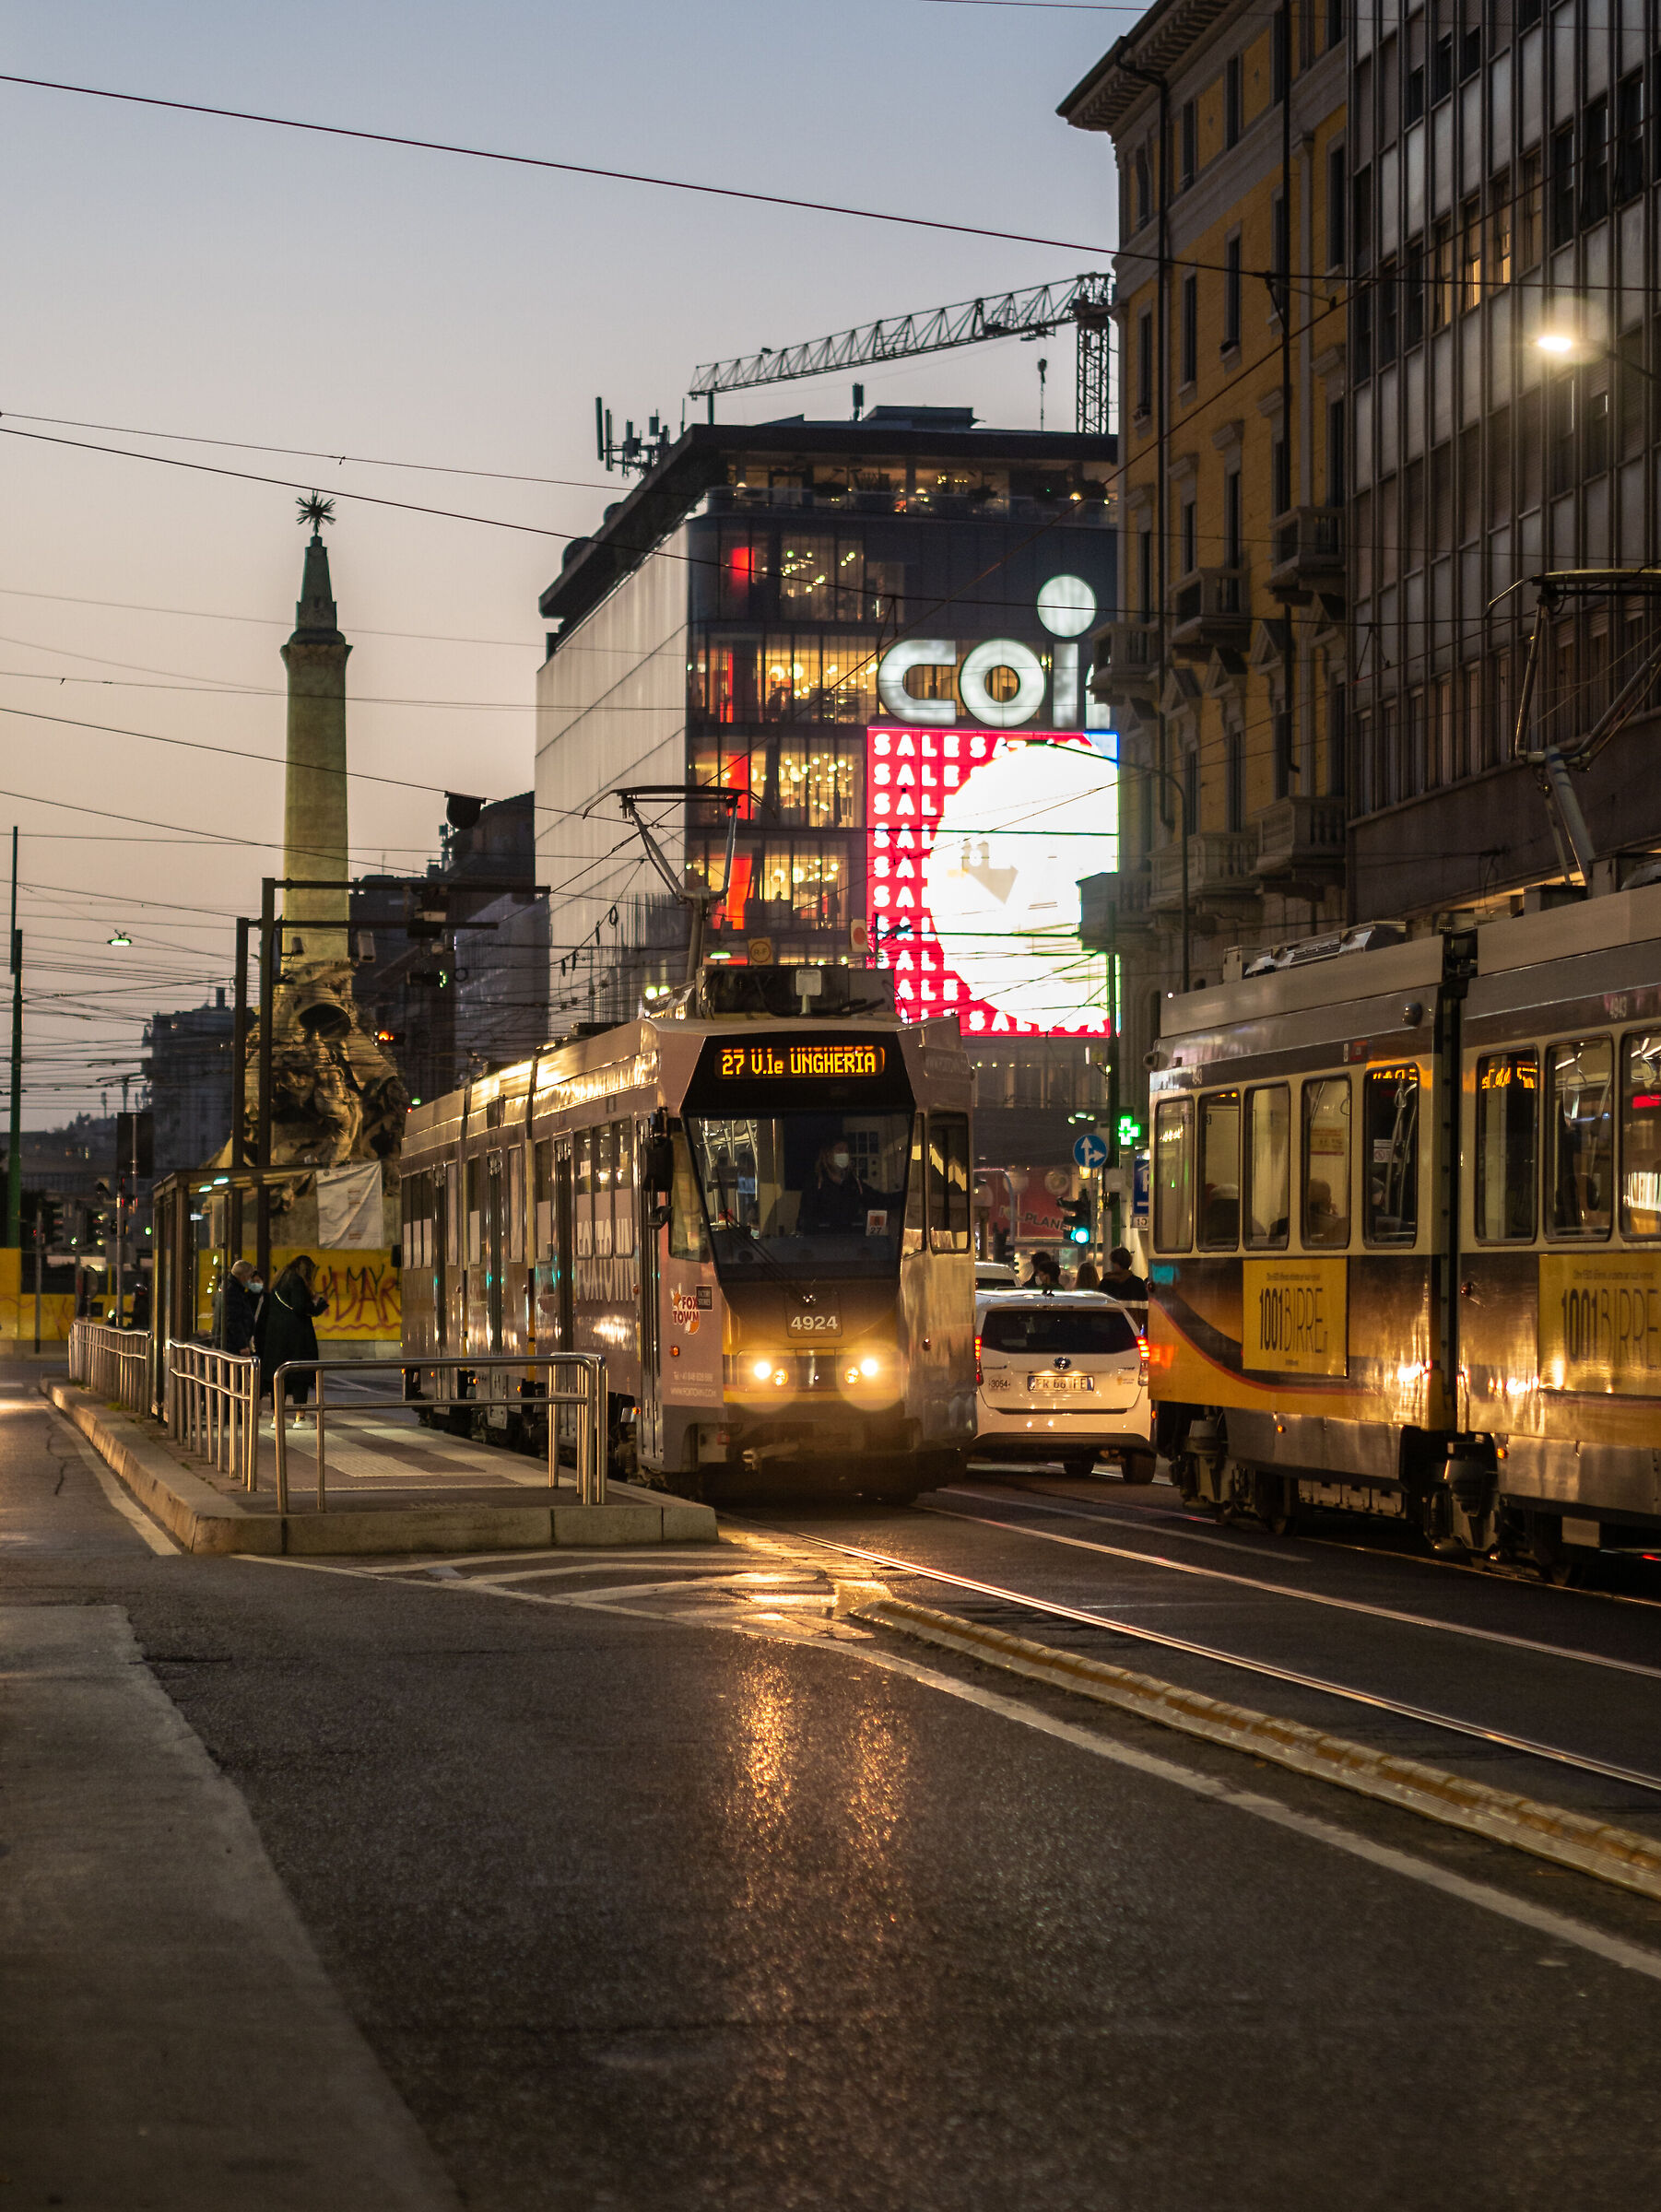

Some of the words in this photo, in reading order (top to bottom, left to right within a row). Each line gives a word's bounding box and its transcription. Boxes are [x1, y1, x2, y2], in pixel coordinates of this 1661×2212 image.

[874, 734, 960, 758] SALE
[874, 763, 960, 787] SALE
[874, 793, 942, 817] SAL
[874, 823, 933, 849] SAL
[876, 949, 938, 971] SAL
[898, 979, 960, 1001] ALE
[722, 1053, 745, 1076] 27
[789, 1052, 876, 1075] UNGHERIA
[870, 1227, 882, 1235] 27
[682, 1296, 698, 1310] FOX
[673, 1311, 699, 1324] TOWN
[791, 1316, 838, 1330] 4924
